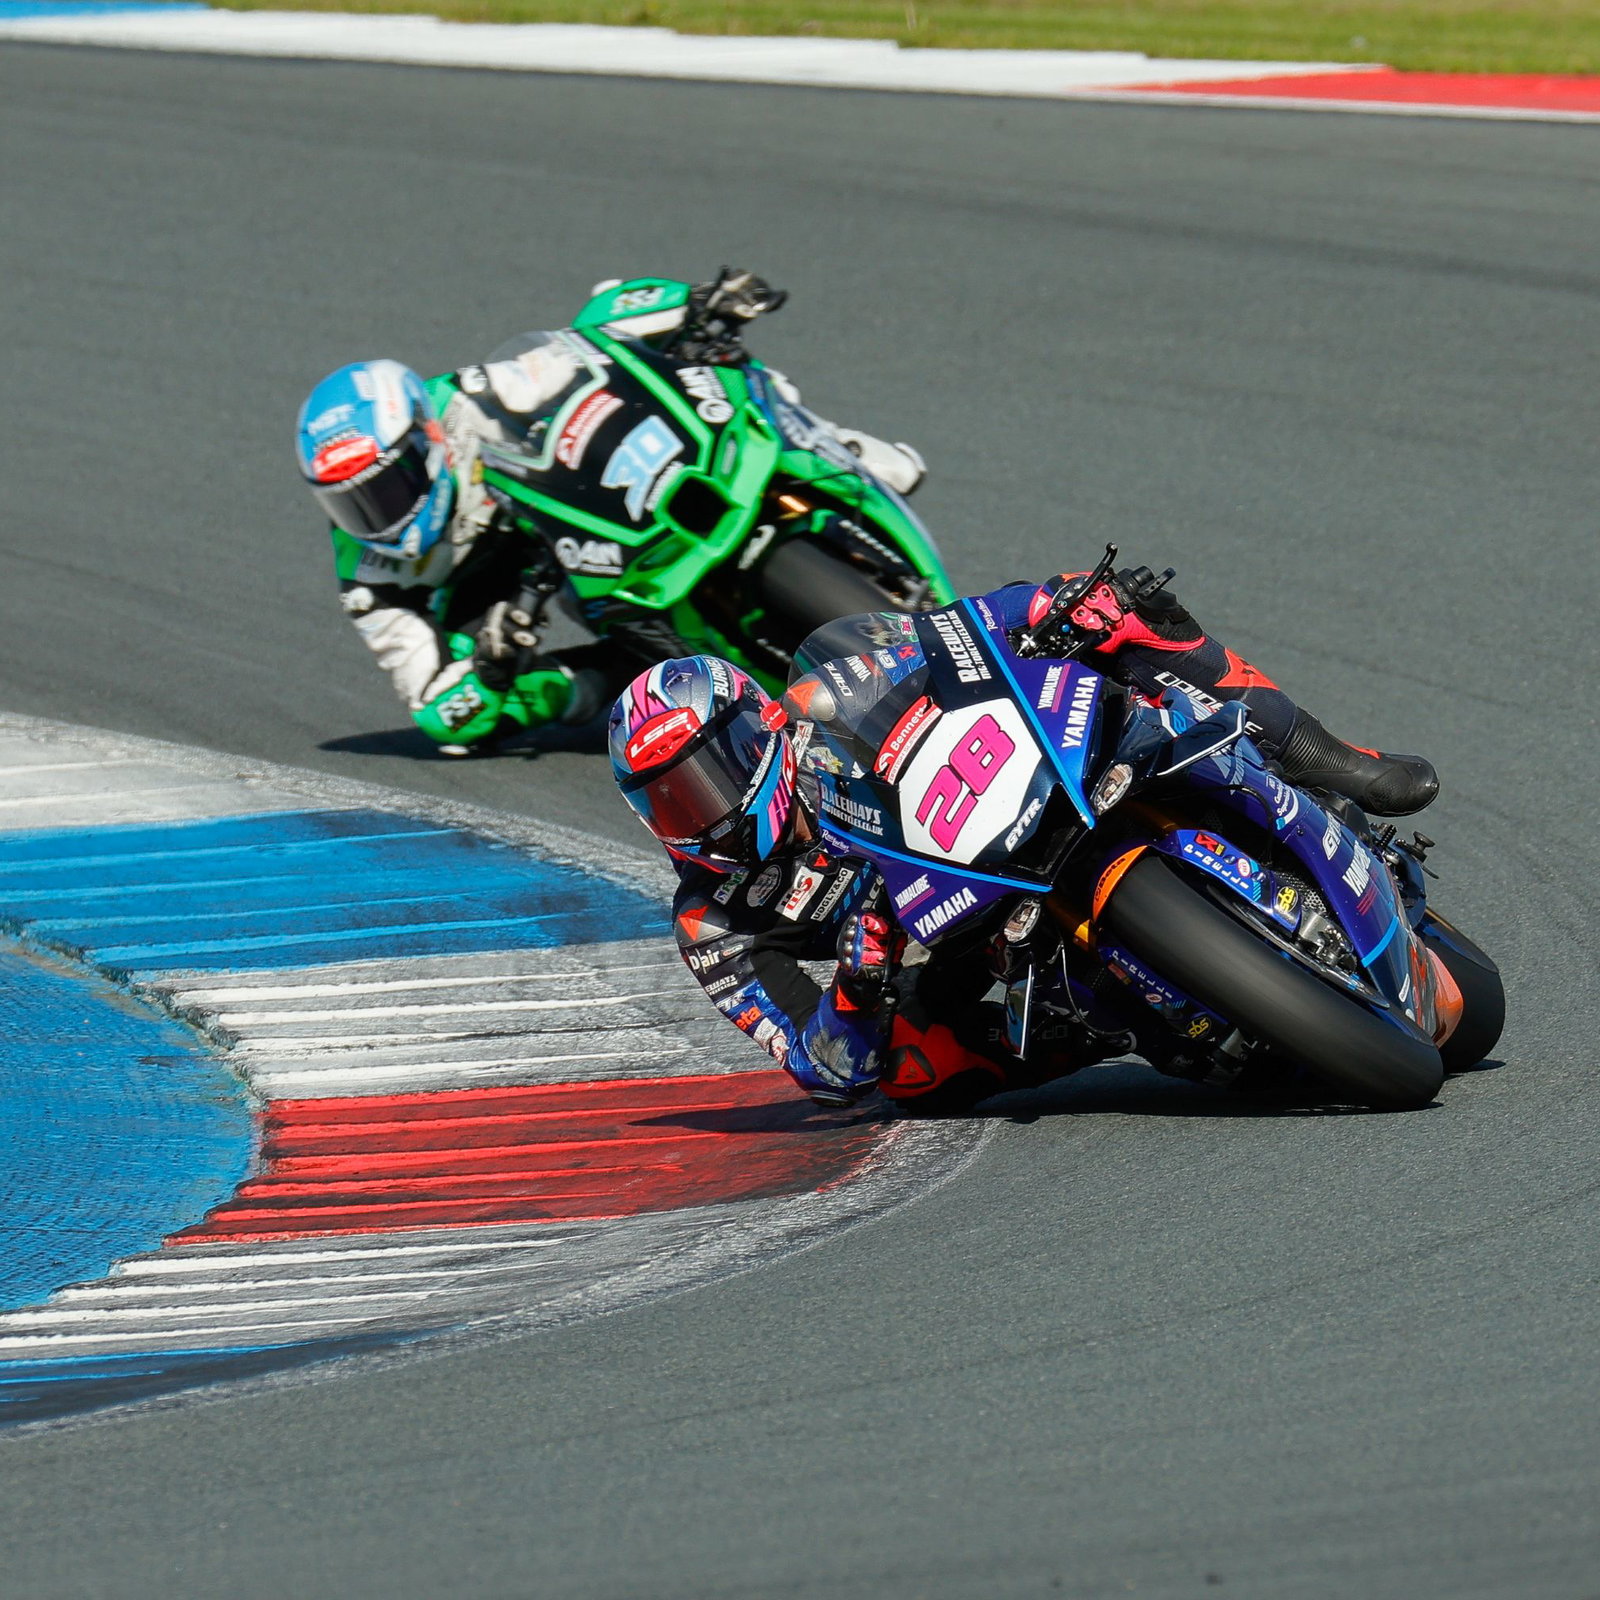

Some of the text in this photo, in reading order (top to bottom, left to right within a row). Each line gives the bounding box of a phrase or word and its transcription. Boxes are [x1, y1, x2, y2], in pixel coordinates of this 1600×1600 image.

[601, 415, 685, 522] 30
[930, 614, 981, 683] RACEWAYS
[1037, 665, 1062, 709] YAMALUBE
[1061, 676, 1098, 748] YAMAHA
[630, 711, 689, 759] LS2
[821, 783, 882, 826] RACEWAYS
[915, 714, 1015, 853] 28
[1004, 798, 1043, 852] GYTR
[1183, 843, 1250, 889] PIRELLI
[895, 874, 931, 910] YAMALUBE
[914, 887, 978, 938] YAMAHA
[1112, 950, 1174, 999] PIRELLI
